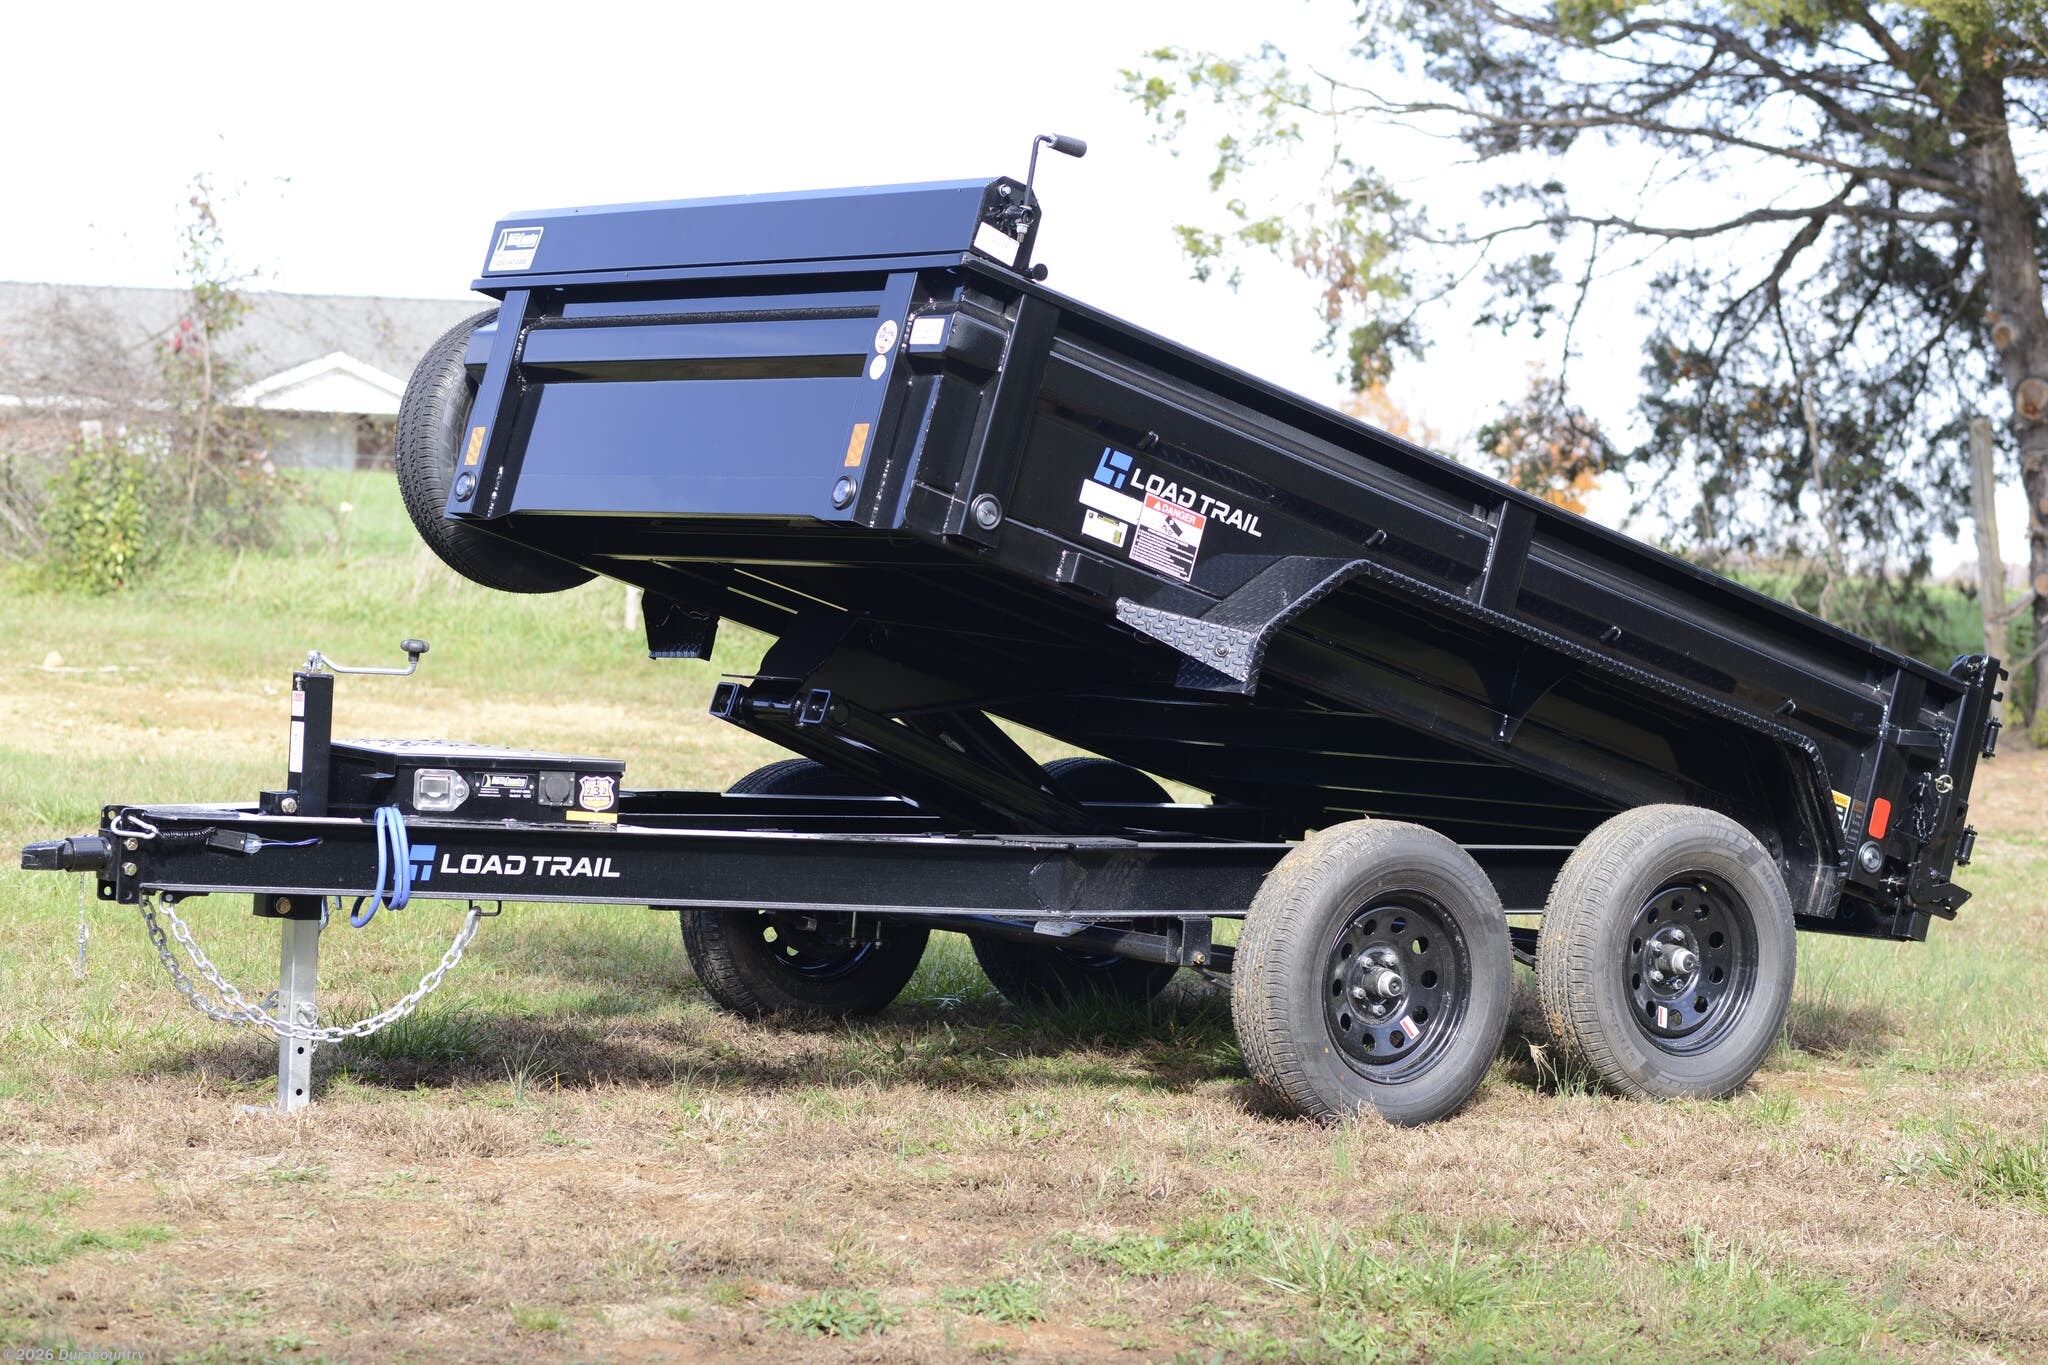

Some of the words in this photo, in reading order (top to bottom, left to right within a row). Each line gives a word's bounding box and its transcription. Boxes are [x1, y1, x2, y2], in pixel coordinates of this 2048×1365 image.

[1130, 468, 1196, 508] LOAD
[1200, 495, 1262, 538] TRAIL
[1163, 504, 1196, 525] DANGER
[440, 853, 527, 876] LOAD
[532, 856, 621, 878] TRAIL
